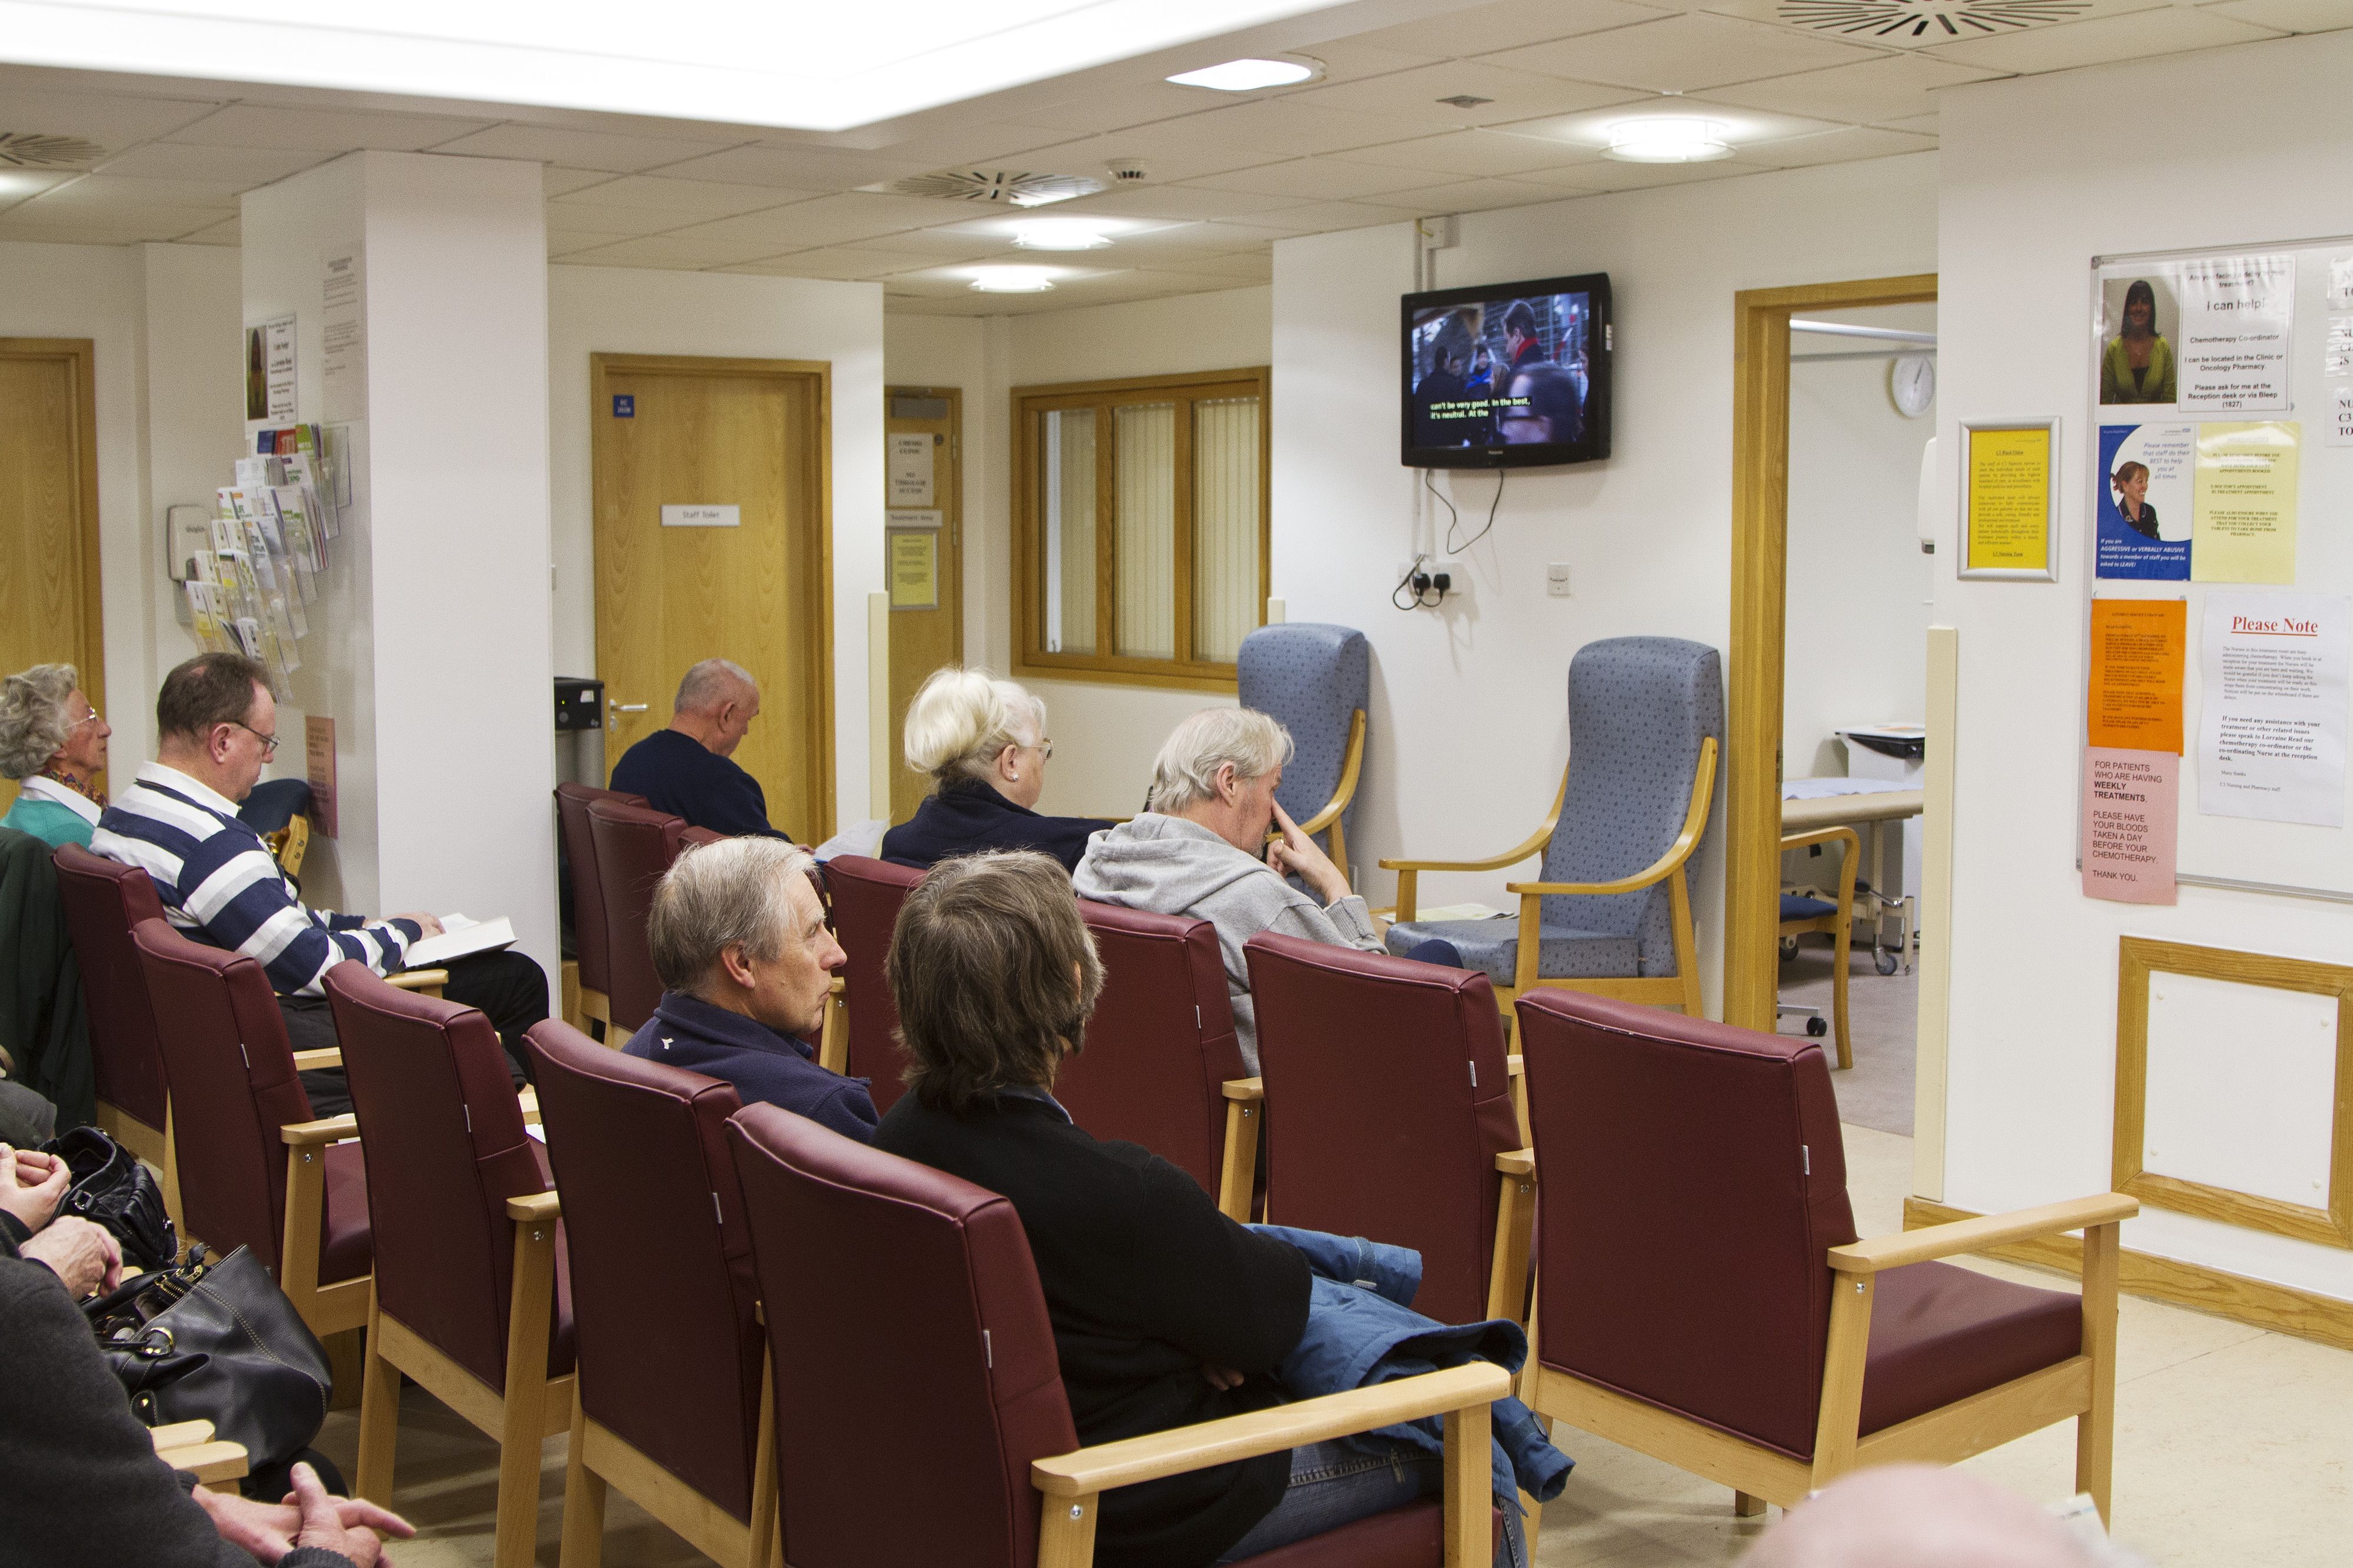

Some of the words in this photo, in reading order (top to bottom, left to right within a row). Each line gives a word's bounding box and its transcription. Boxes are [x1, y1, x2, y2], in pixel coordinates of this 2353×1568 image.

[2207, 301, 2209, 311] I
[2214, 302, 2232, 311] can
[2237, 298, 2265, 310] help!
[1430, 402, 1446, 411] can't
[1471, 399, 1490, 409] good.
[1512, 397, 1530, 406] best,
[2339, 413, 2351, 422] C3
[2232, 616, 2278, 631] Please
[2283, 618, 2318, 633] Note
[2095, 761, 2111, 769] FOR
[2113, 762, 2150, 772] PATIENTS
[2095, 771, 2113, 779] WHO
[2132, 775, 2162, 783] HAVING
[2094, 781, 2126, 790] WEEKLY
[2094, 791, 2147, 802] TREATMENTS.
[2094, 810, 2122, 820] PLEASE
[2124, 813, 2145, 822] HAVE
[2093, 821, 2114, 829] YOUR
[2117, 823, 2148, 833] BLOODS
[2093, 830, 2117, 839] TAKEN
[2093, 841, 2123, 850] BEFORE
[2125, 844, 2147, 852] YOUR
[2093, 850, 2158, 864] CHEMOTHERAPY.
[2093, 870, 2118, 879] THANK
[2120, 873, 2137, 882] YOU.
